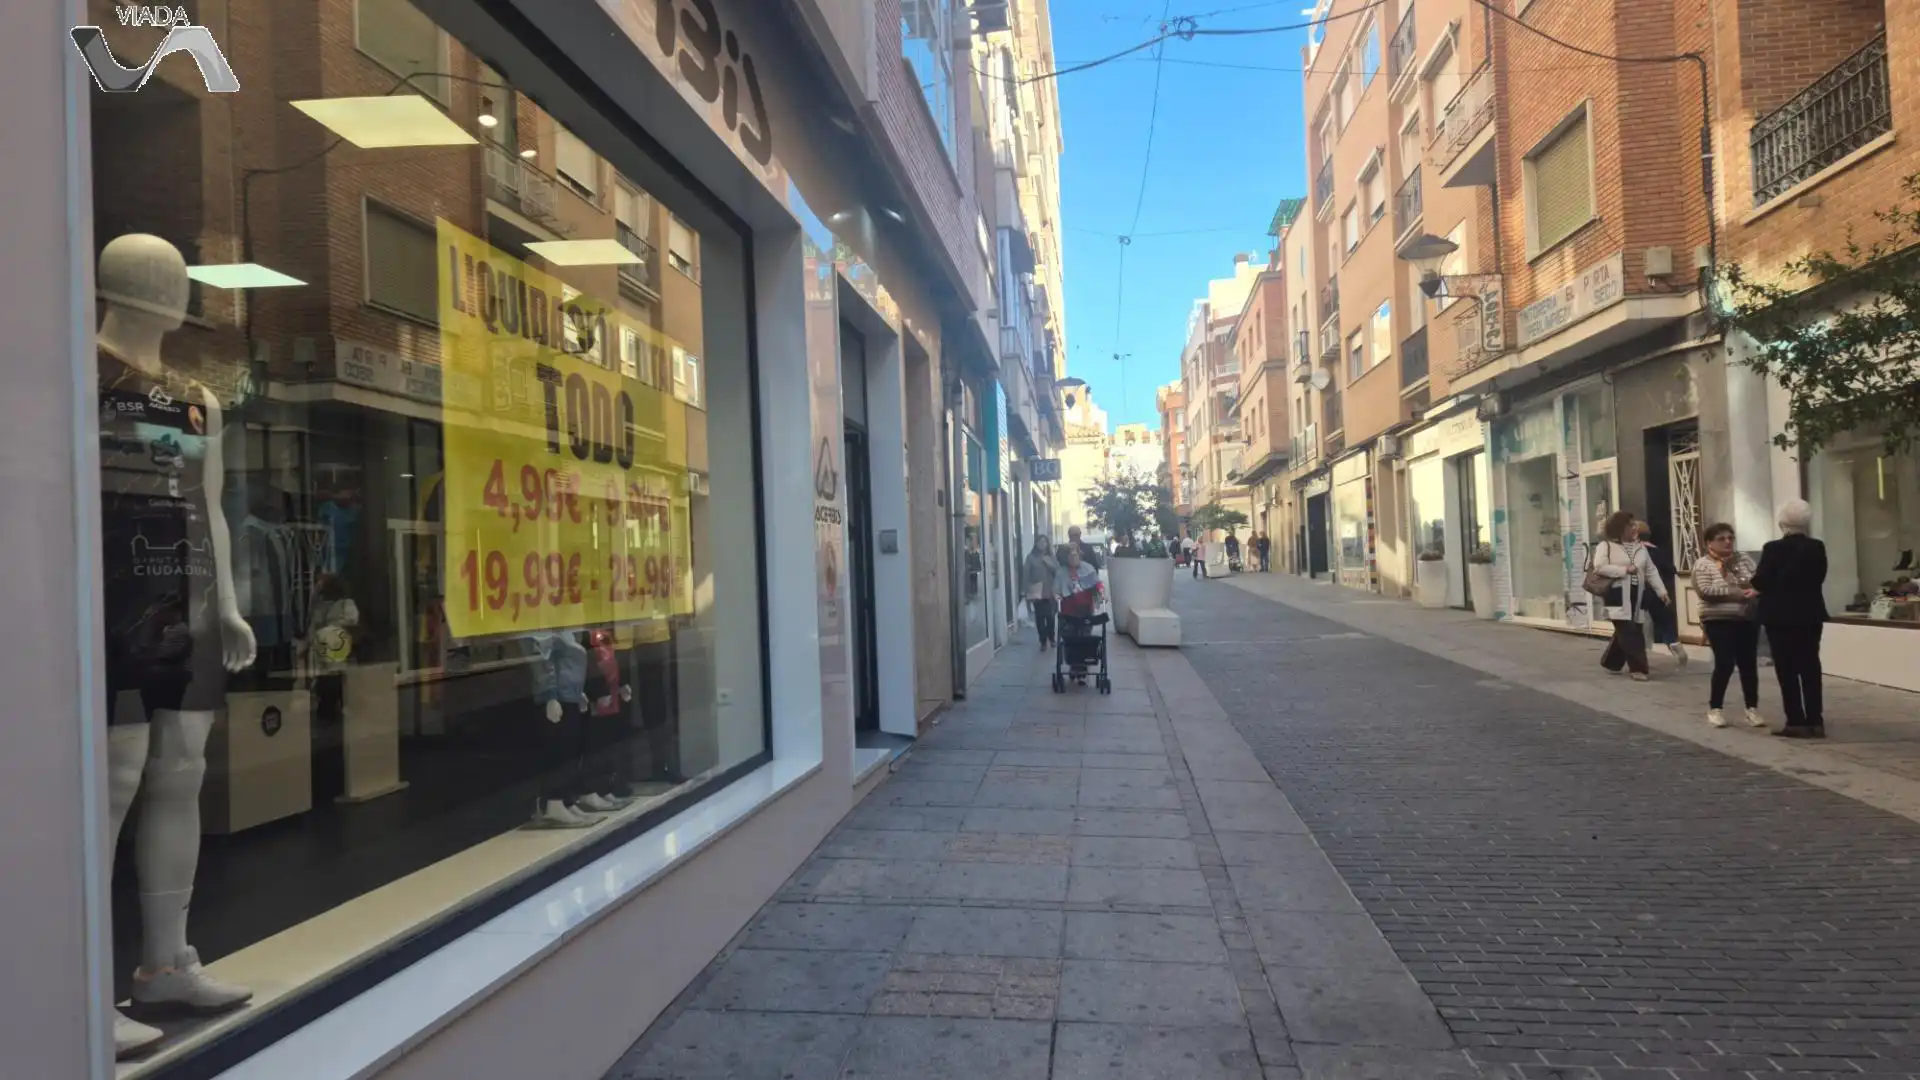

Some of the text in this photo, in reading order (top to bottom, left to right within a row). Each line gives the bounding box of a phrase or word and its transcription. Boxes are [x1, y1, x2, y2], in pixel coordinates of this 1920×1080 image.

[536, 361, 635, 471] TODO
[483, 458, 582, 534] 4,99€
[461, 550, 582, 623] 19,99€
